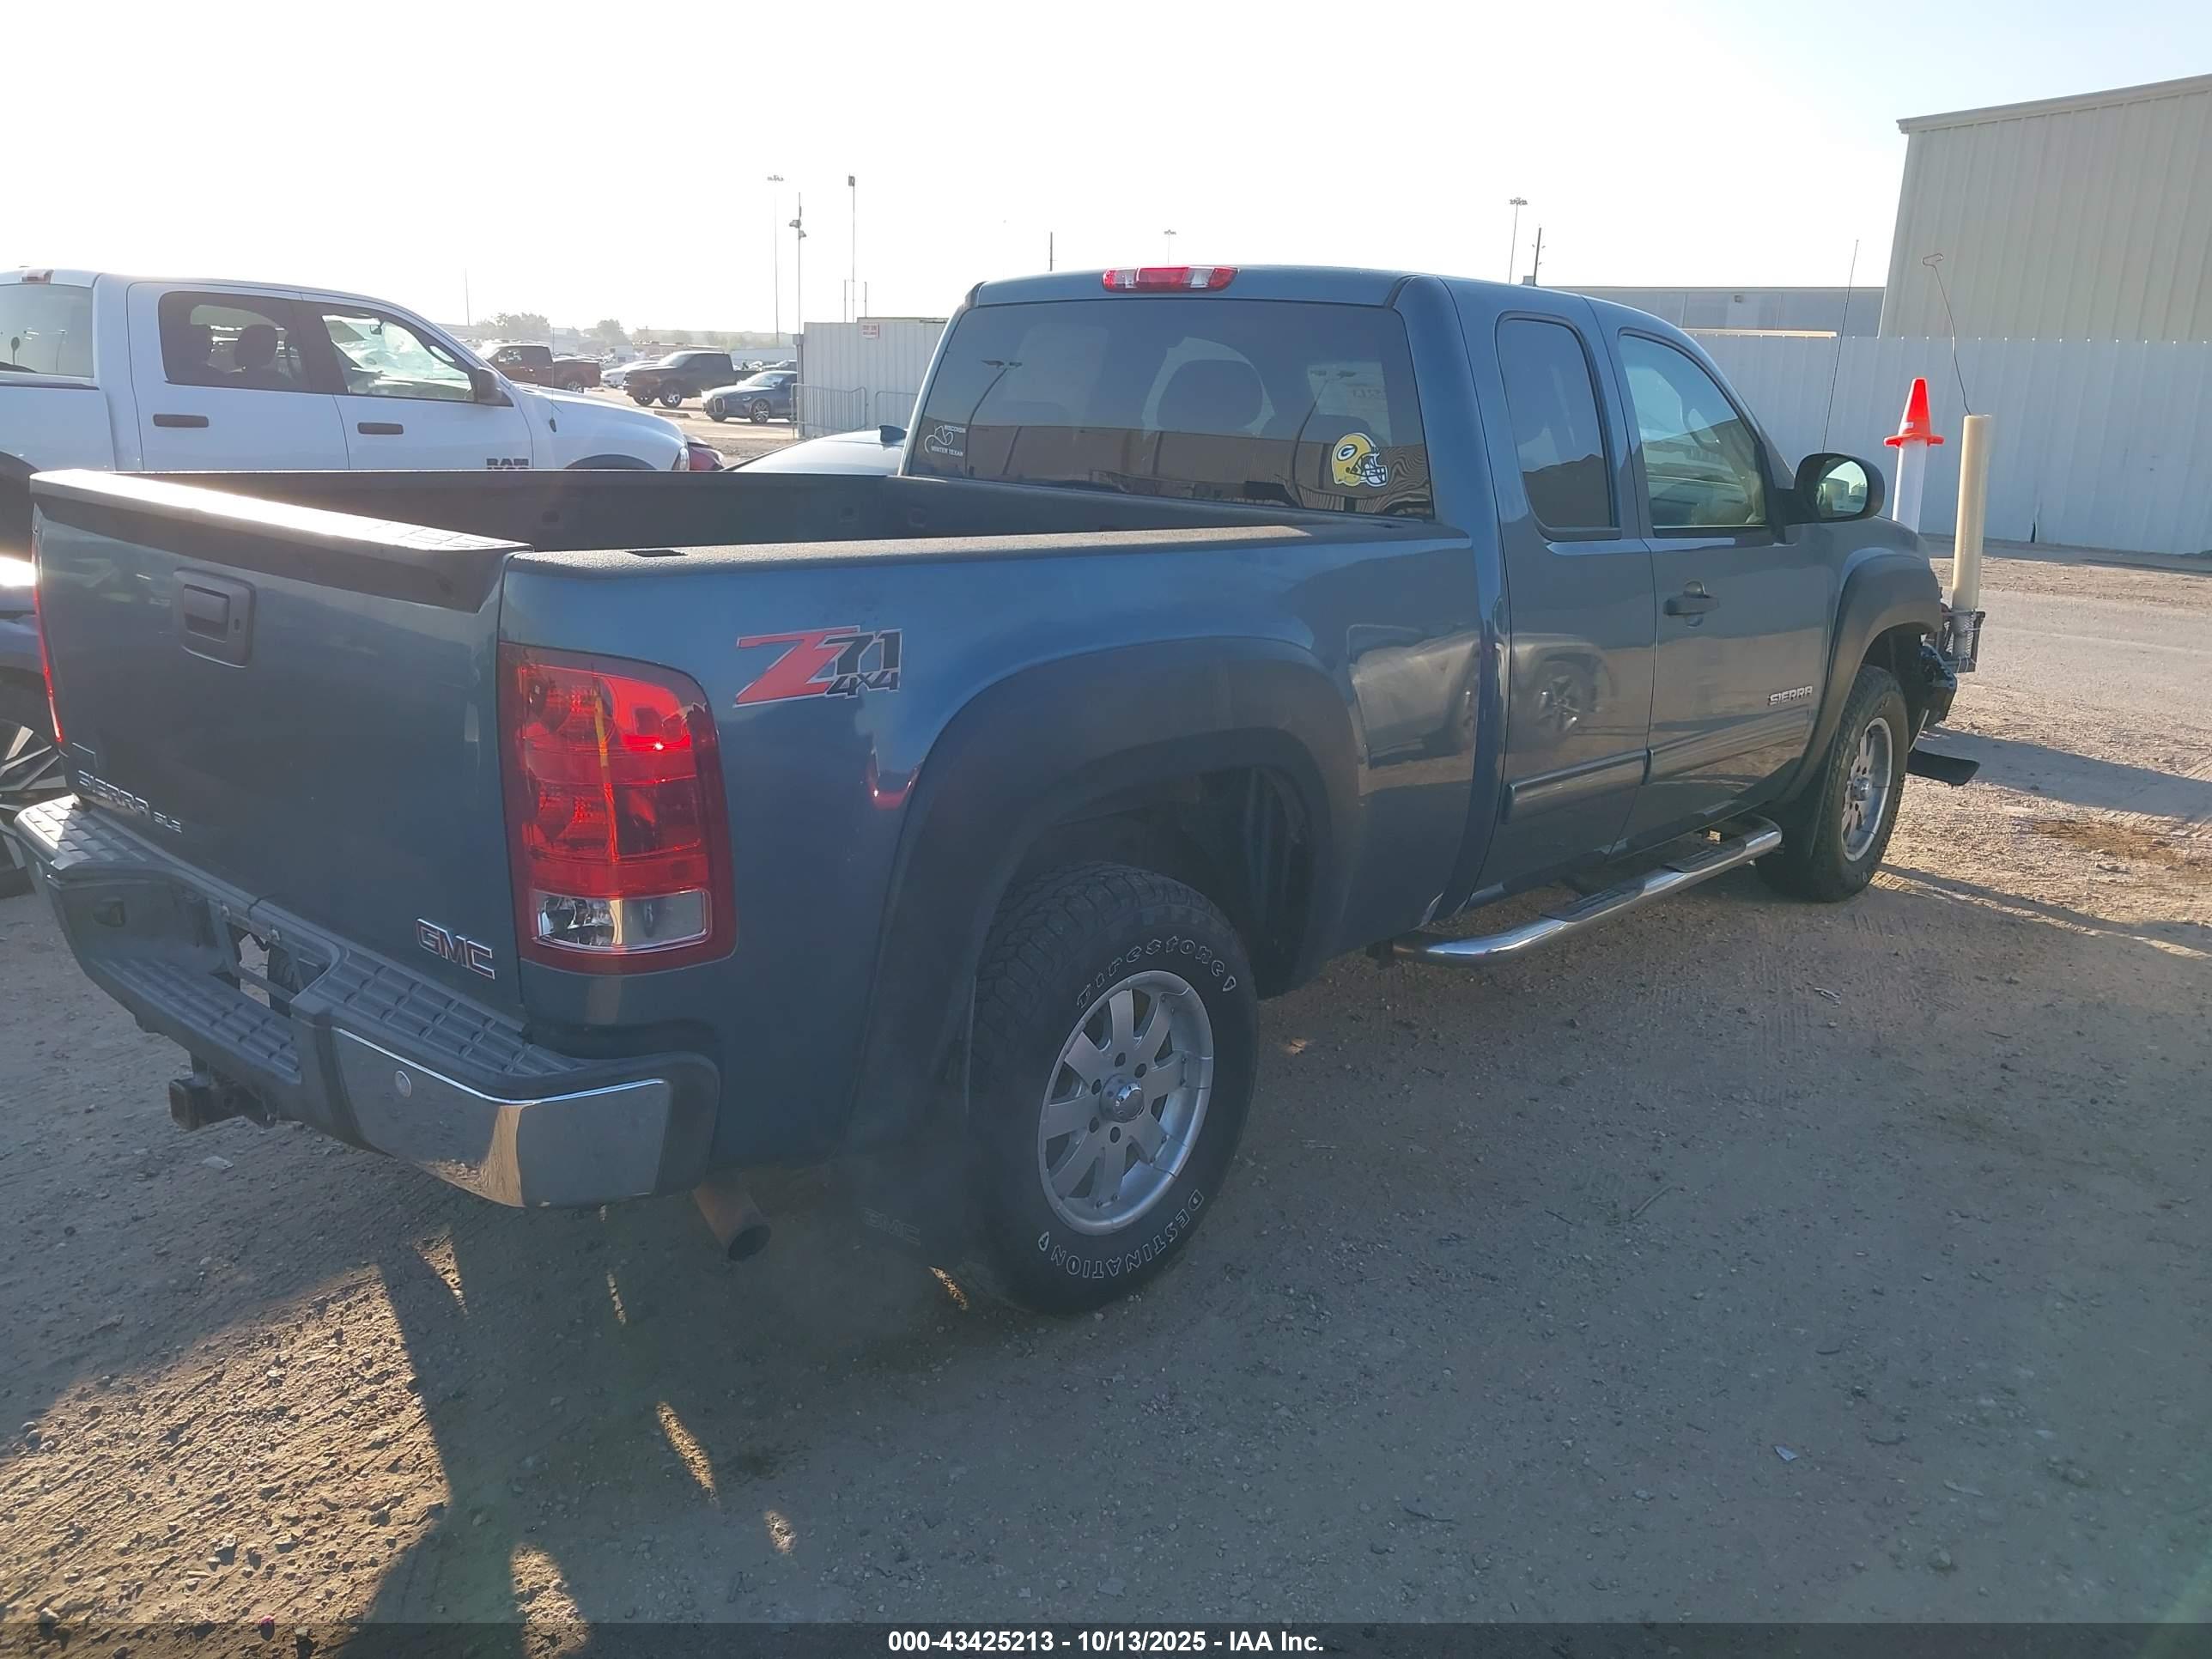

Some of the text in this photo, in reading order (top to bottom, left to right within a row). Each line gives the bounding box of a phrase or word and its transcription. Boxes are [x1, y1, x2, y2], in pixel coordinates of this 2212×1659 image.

[486, 458, 529, 466] RAM
[733, 625, 902, 708] Z71
[1769, 685, 1813, 705] SIERRA
[78, 769, 183, 835] SIERRA SLE
[416, 917, 495, 980] GMC
[1050, 1188, 1205, 1279] DESTINATION
